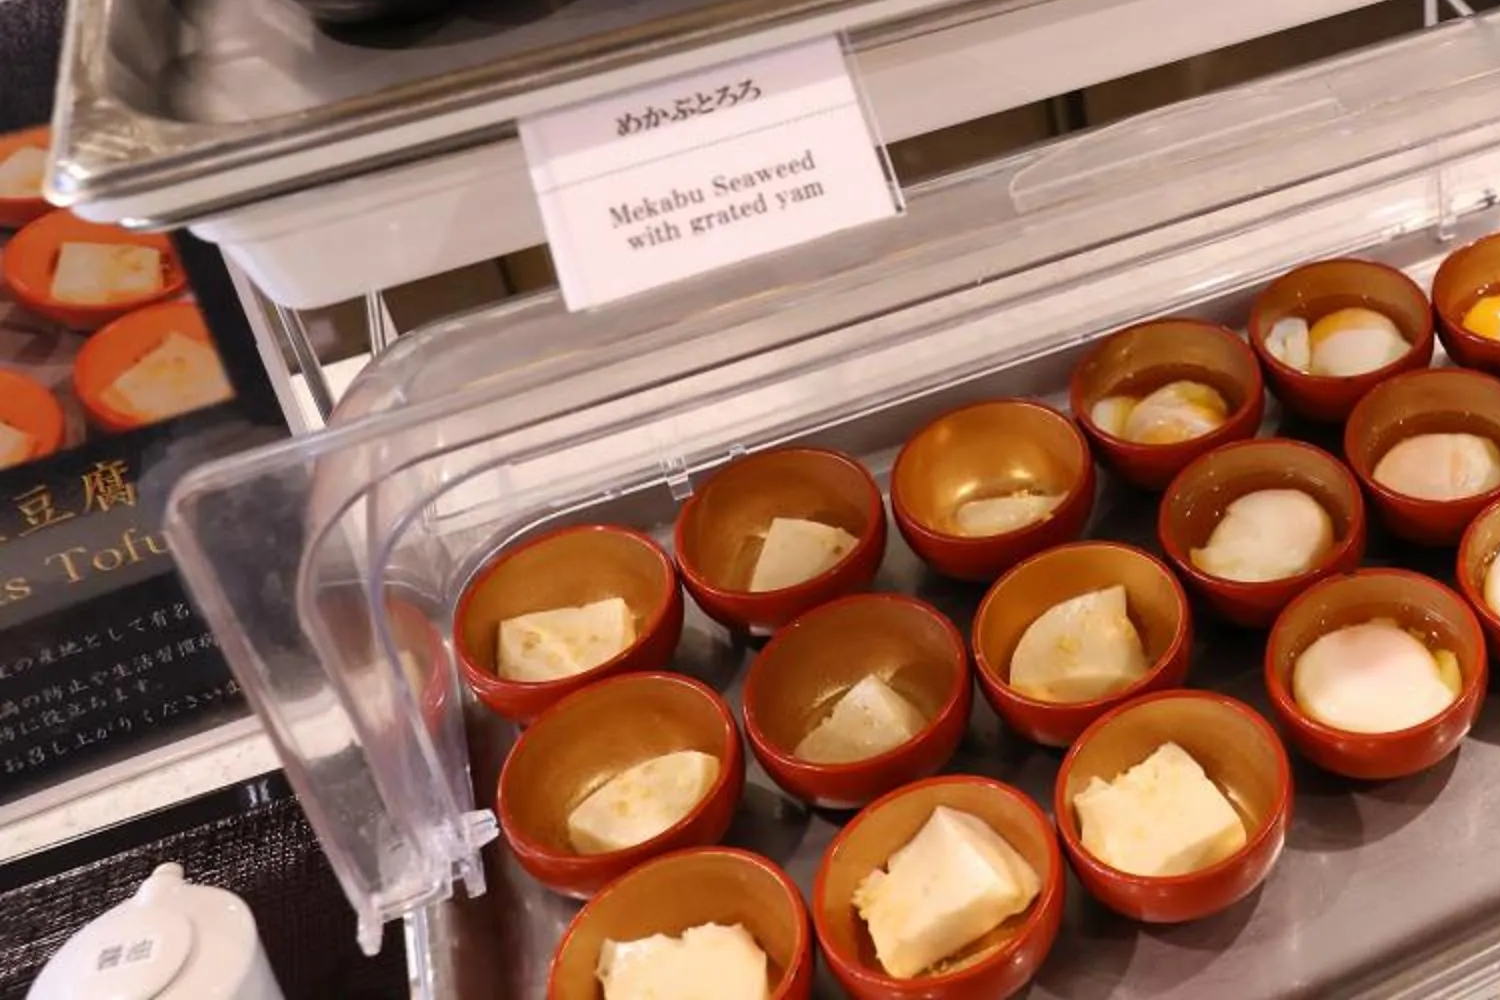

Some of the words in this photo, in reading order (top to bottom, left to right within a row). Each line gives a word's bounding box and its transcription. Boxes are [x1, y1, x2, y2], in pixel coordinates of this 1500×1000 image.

[615, 79, 762, 137] めかぶとろろ
[610, 187, 706, 229] Mekabu
[711, 150, 817, 196] Seaweed
[628, 217, 682, 252] with
[689, 193, 768, 235] grated
[776, 181, 826, 211] yam
[0, 459, 138, 544] 豆腐
[44, 528, 171, 585] Tofu
